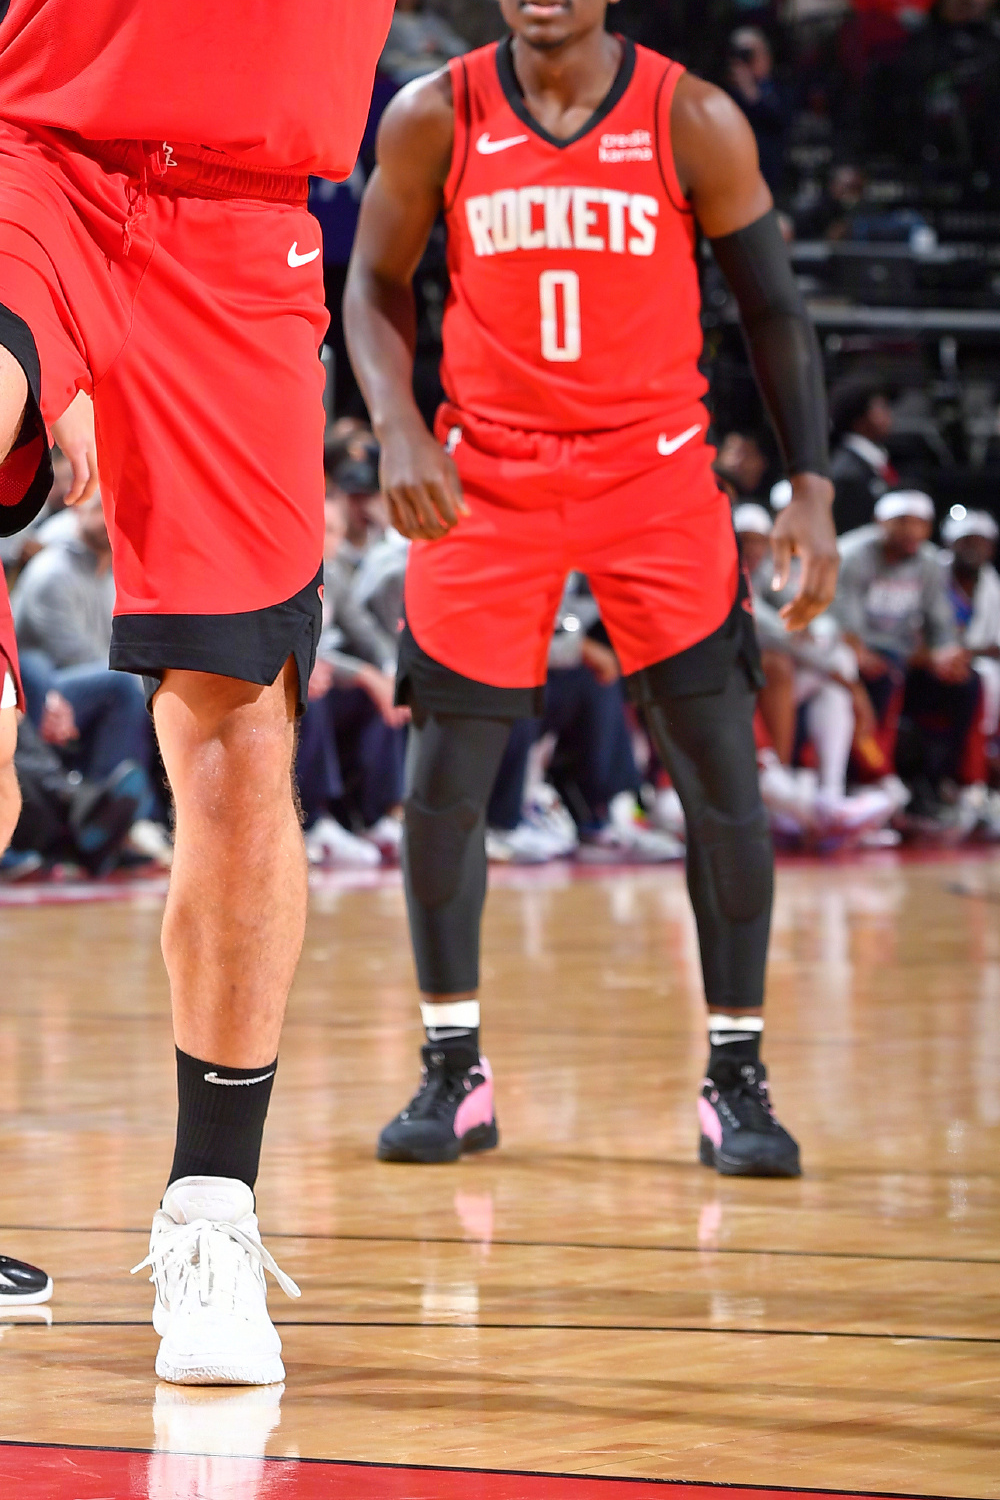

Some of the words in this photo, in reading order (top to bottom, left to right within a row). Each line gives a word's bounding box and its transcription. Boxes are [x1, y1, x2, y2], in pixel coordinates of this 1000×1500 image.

[598, 146, 653, 163] karma
[600, 130, 651, 149] credit
[465, 185, 660, 257] ROCKETS
[538, 269, 582, 363] 0
